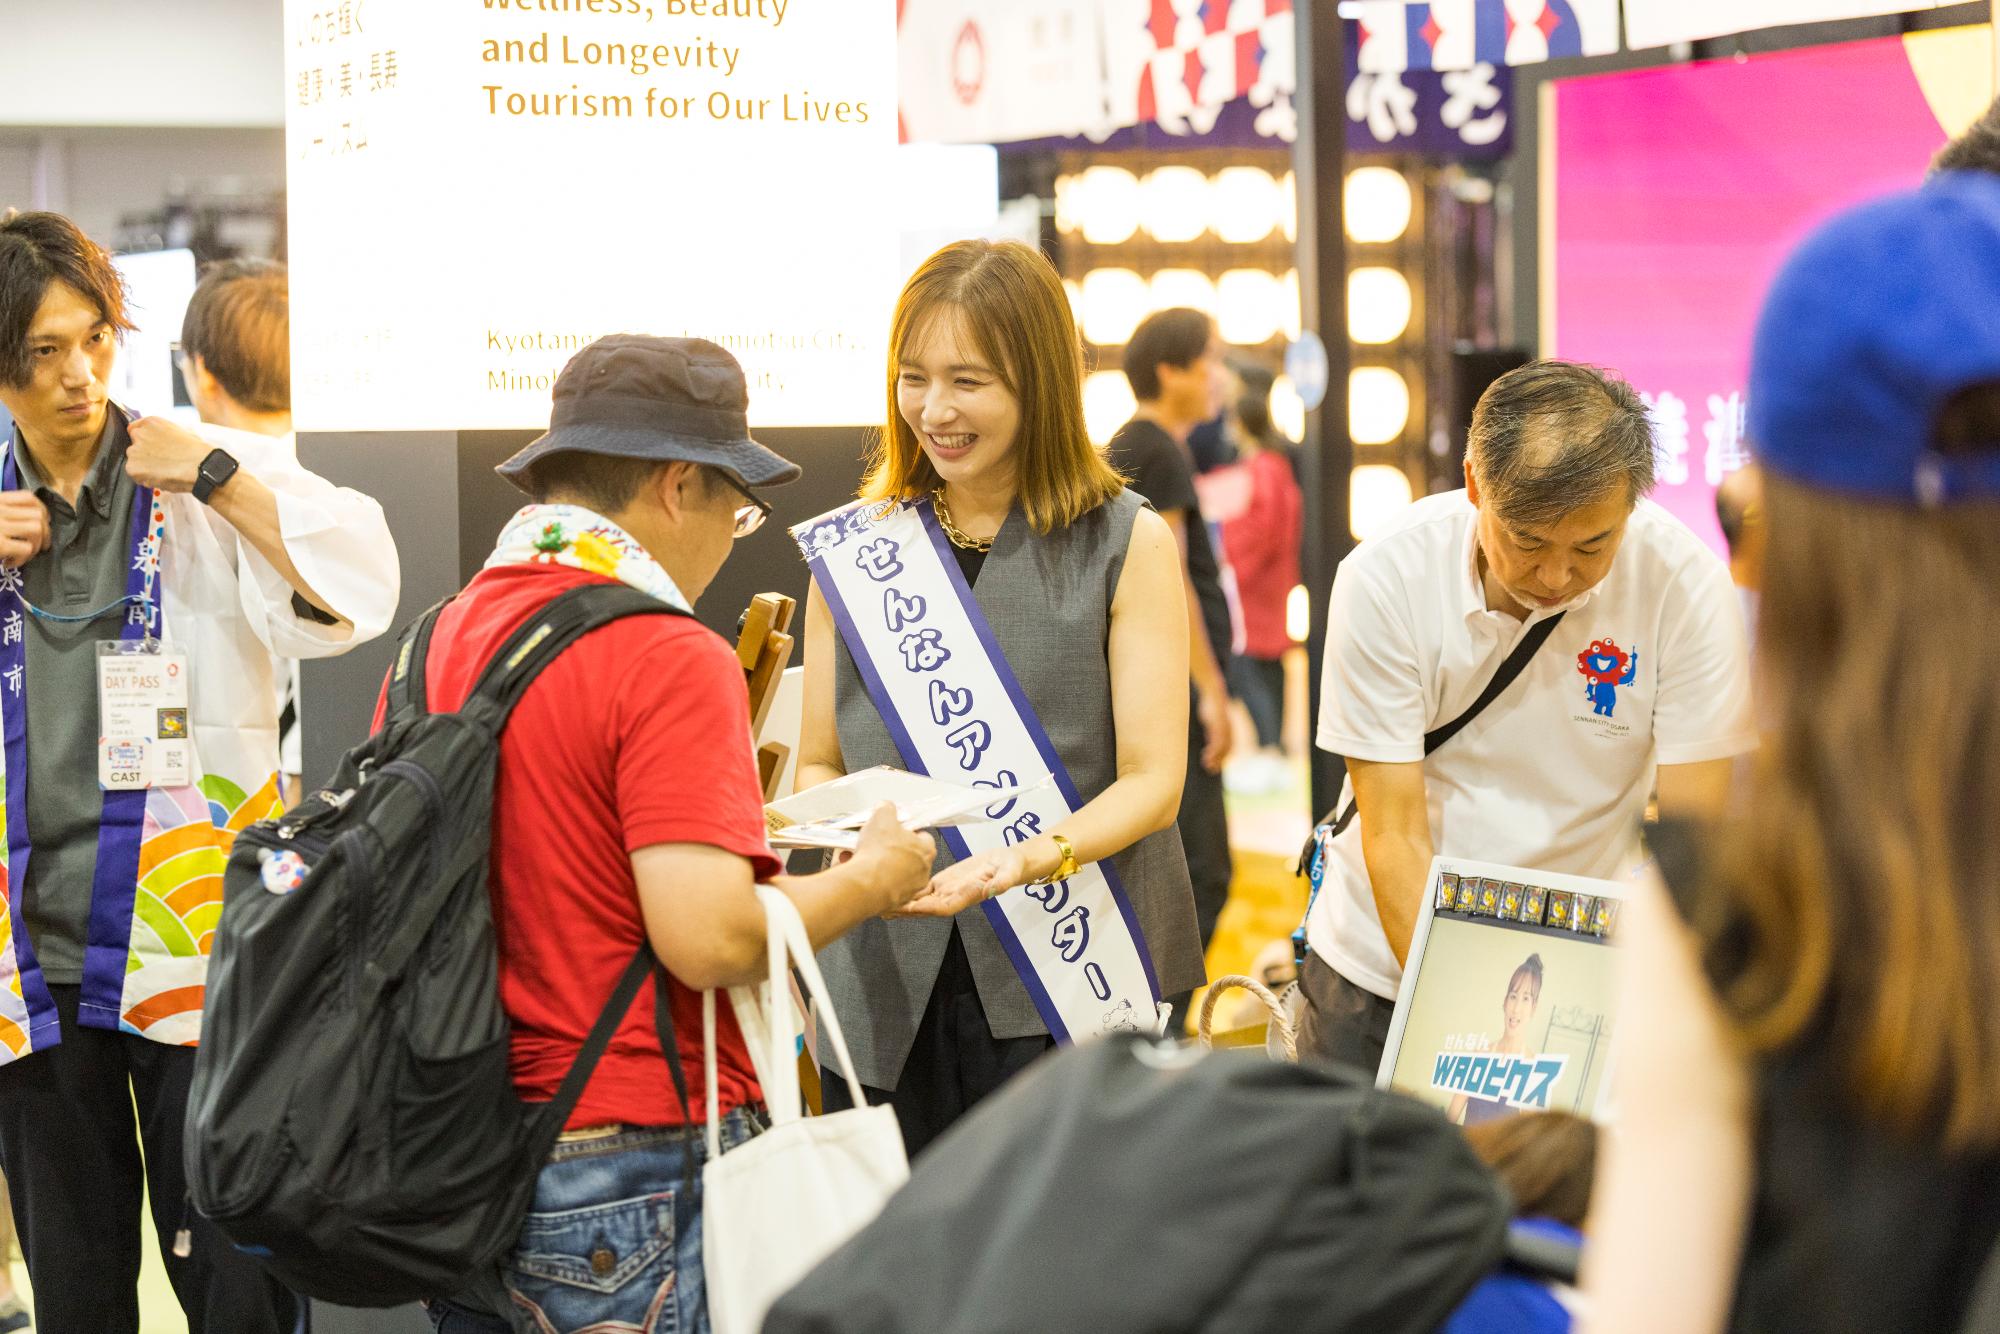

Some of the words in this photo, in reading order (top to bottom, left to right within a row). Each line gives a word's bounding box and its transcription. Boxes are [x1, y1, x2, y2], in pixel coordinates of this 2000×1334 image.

[482, 32, 549, 63] and
[563, 36, 740, 76] Longevity
[482, 85, 633, 117] Tourism
[645, 87, 696, 119] for
[707, 92, 771, 120] Our
[784, 91, 869, 123] Lives
[488, 330, 593, 356] Kyotan
[106, 676, 127, 689] DAY
[131, 676, 160, 689] PASS
[110, 772, 141, 783] CAST
